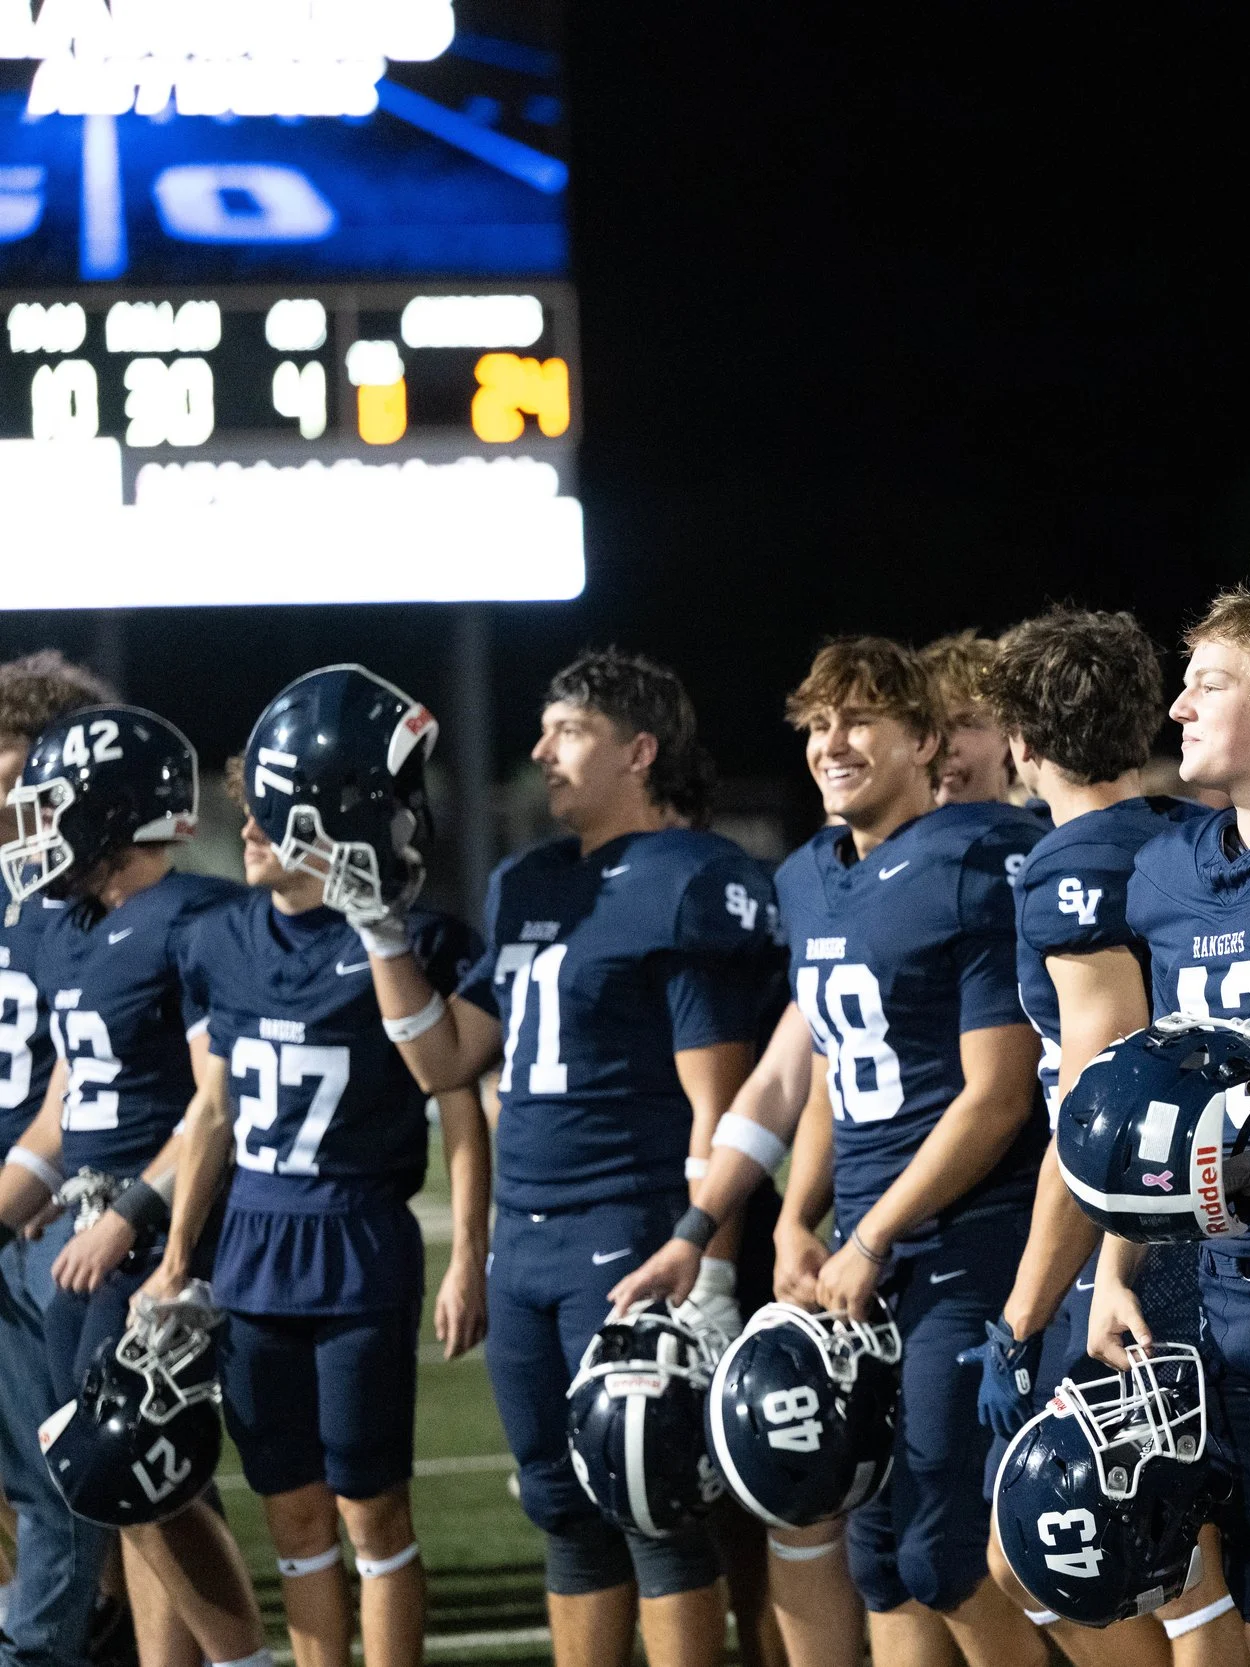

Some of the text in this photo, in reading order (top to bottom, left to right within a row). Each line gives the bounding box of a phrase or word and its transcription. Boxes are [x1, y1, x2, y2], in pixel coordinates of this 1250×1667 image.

[62, 719, 123, 767] 42
[254, 747, 297, 797] 71
[1057, 876, 1103, 925] SV
[1193, 930, 1246, 959] RANGERS
[494, 943, 568, 1095] 71
[231, 1036, 350, 1176] 27
[1197, 1146, 1229, 1234] Riddell
[766, 1385, 821, 1453] 48
[132, 1436, 192, 1501] 27
[1037, 1507, 1103, 1578] 43
